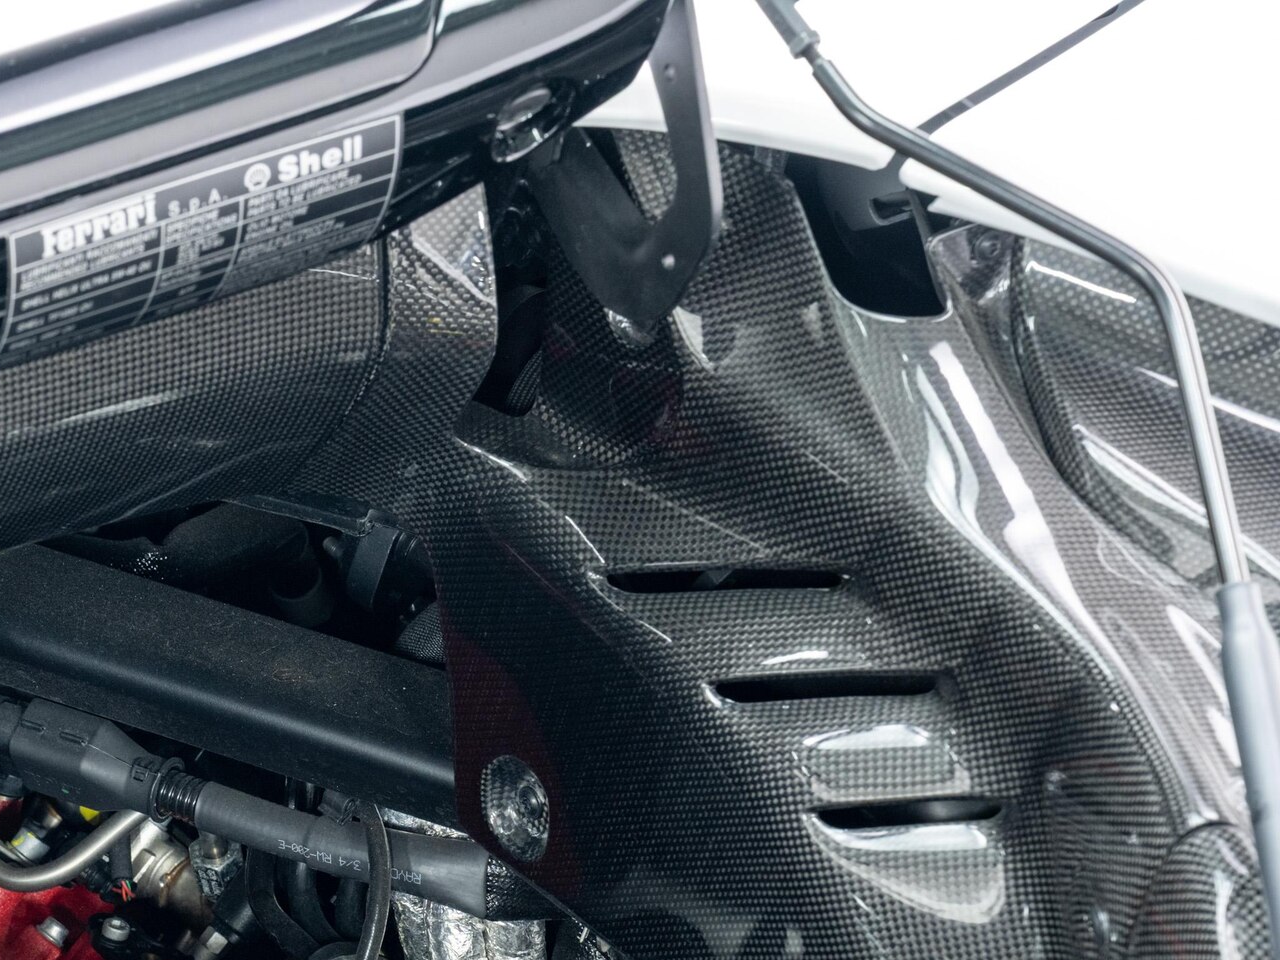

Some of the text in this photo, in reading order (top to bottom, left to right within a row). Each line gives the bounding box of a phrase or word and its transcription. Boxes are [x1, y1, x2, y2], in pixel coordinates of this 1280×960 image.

[277, 134, 363, 183] Shell
[41, 193, 158, 260] Ferrari
[338, 855, 362, 871] 3/4
